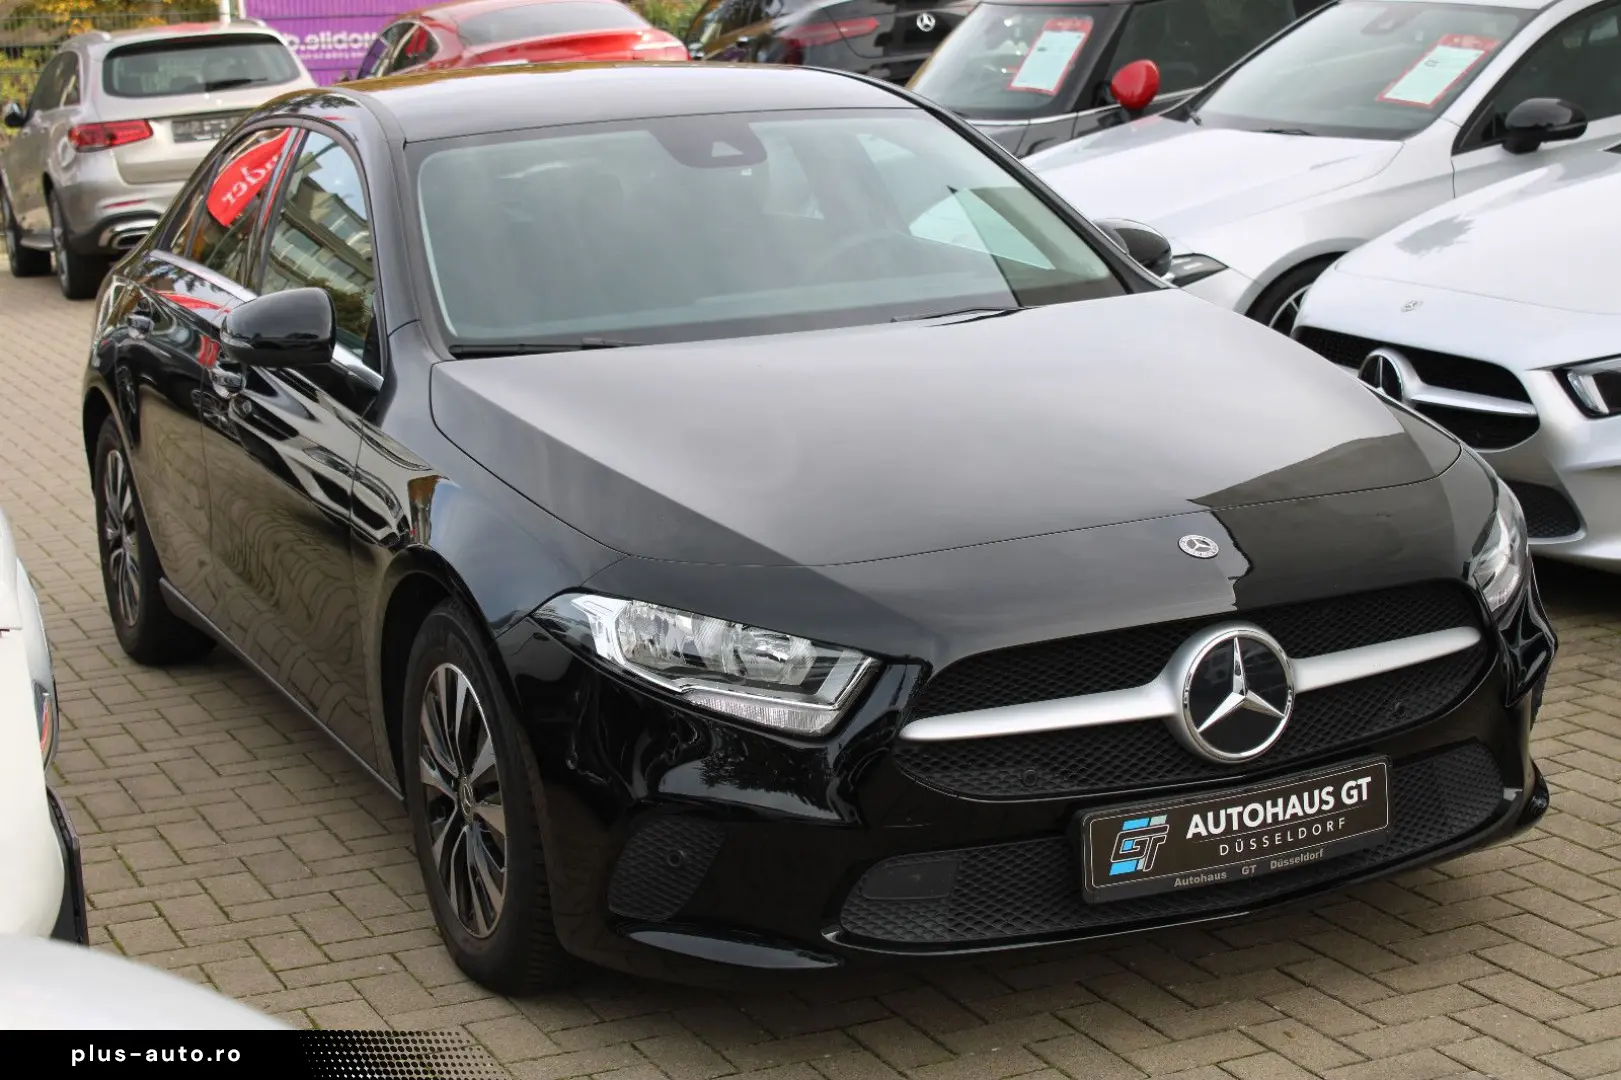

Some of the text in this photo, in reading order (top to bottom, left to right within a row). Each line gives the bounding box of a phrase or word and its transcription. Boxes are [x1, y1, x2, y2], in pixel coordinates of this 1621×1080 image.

[1186, 776, 1372, 839] AUTOHAUS GT
[1219, 817, 1347, 856] DÜSSELDORF
[1173, 848, 1324, 888] Autohaus GT Düsseldorf
